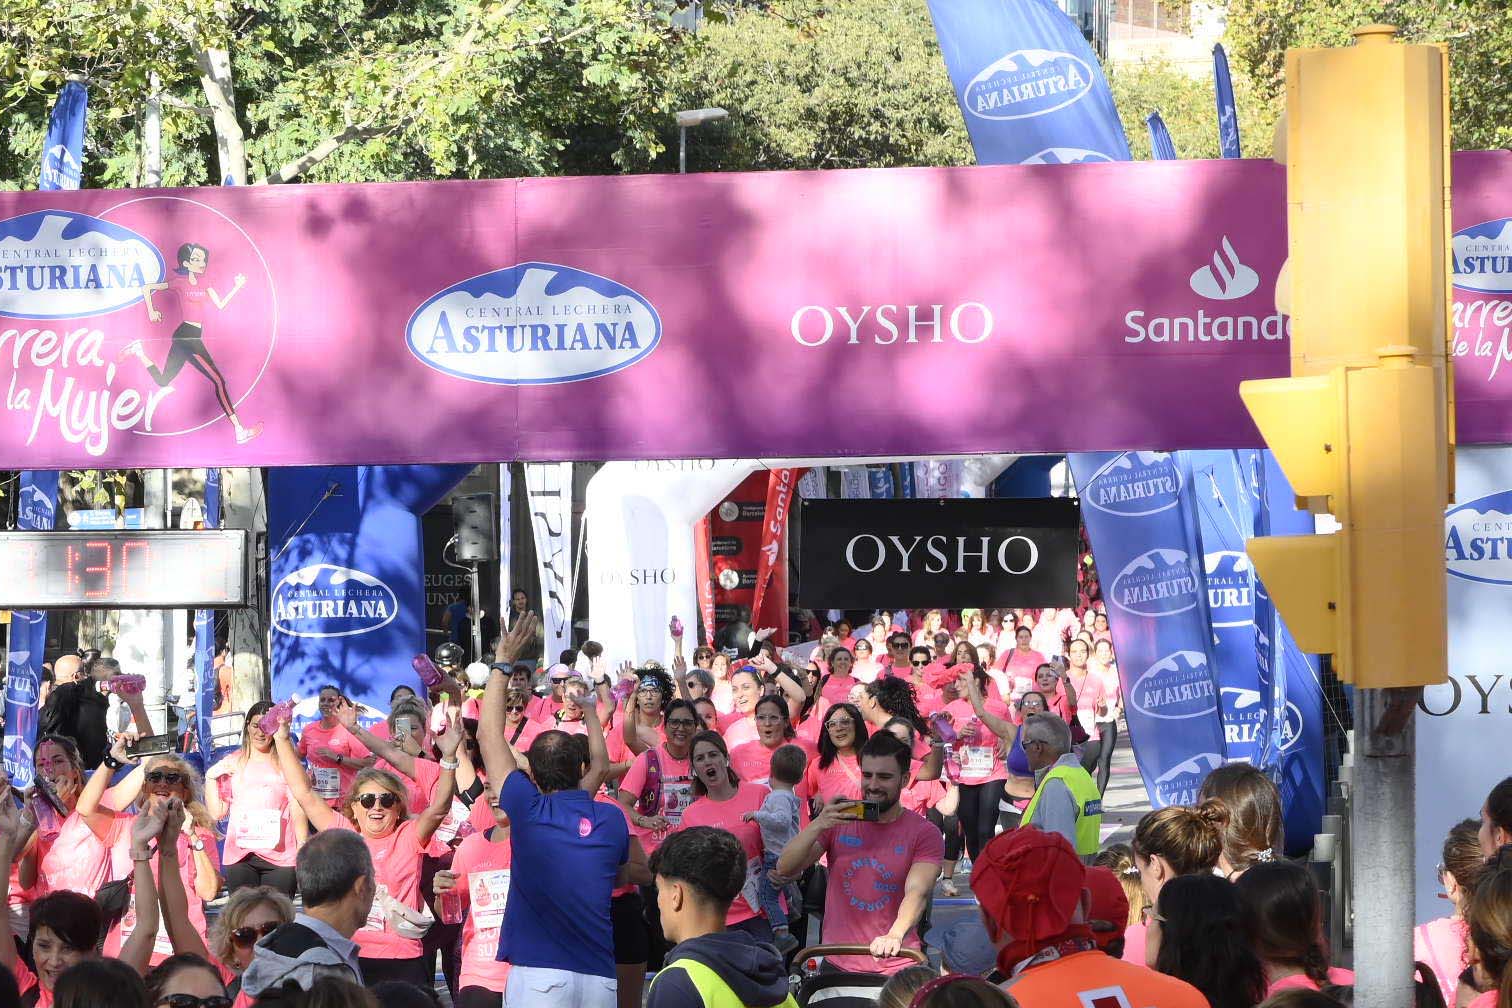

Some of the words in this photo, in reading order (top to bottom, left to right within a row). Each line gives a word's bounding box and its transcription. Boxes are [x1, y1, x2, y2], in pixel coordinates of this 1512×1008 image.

[465, 306, 545, 319] CENTRAL
[551, 303, 633, 316] LECHERA
[790, 302, 995, 346] OYSHO
[425, 310, 642, 354] ASTURIANA
[6, 371, 32, 410] la
[25, 362, 176, 456] Mujer
[845, 534, 1040, 575] OYSHO
[275, 595, 388, 620] ASTURIANA
[288, 590, 332, 598] CENTRAL
[335, 589, 384, 597] LECHERA
